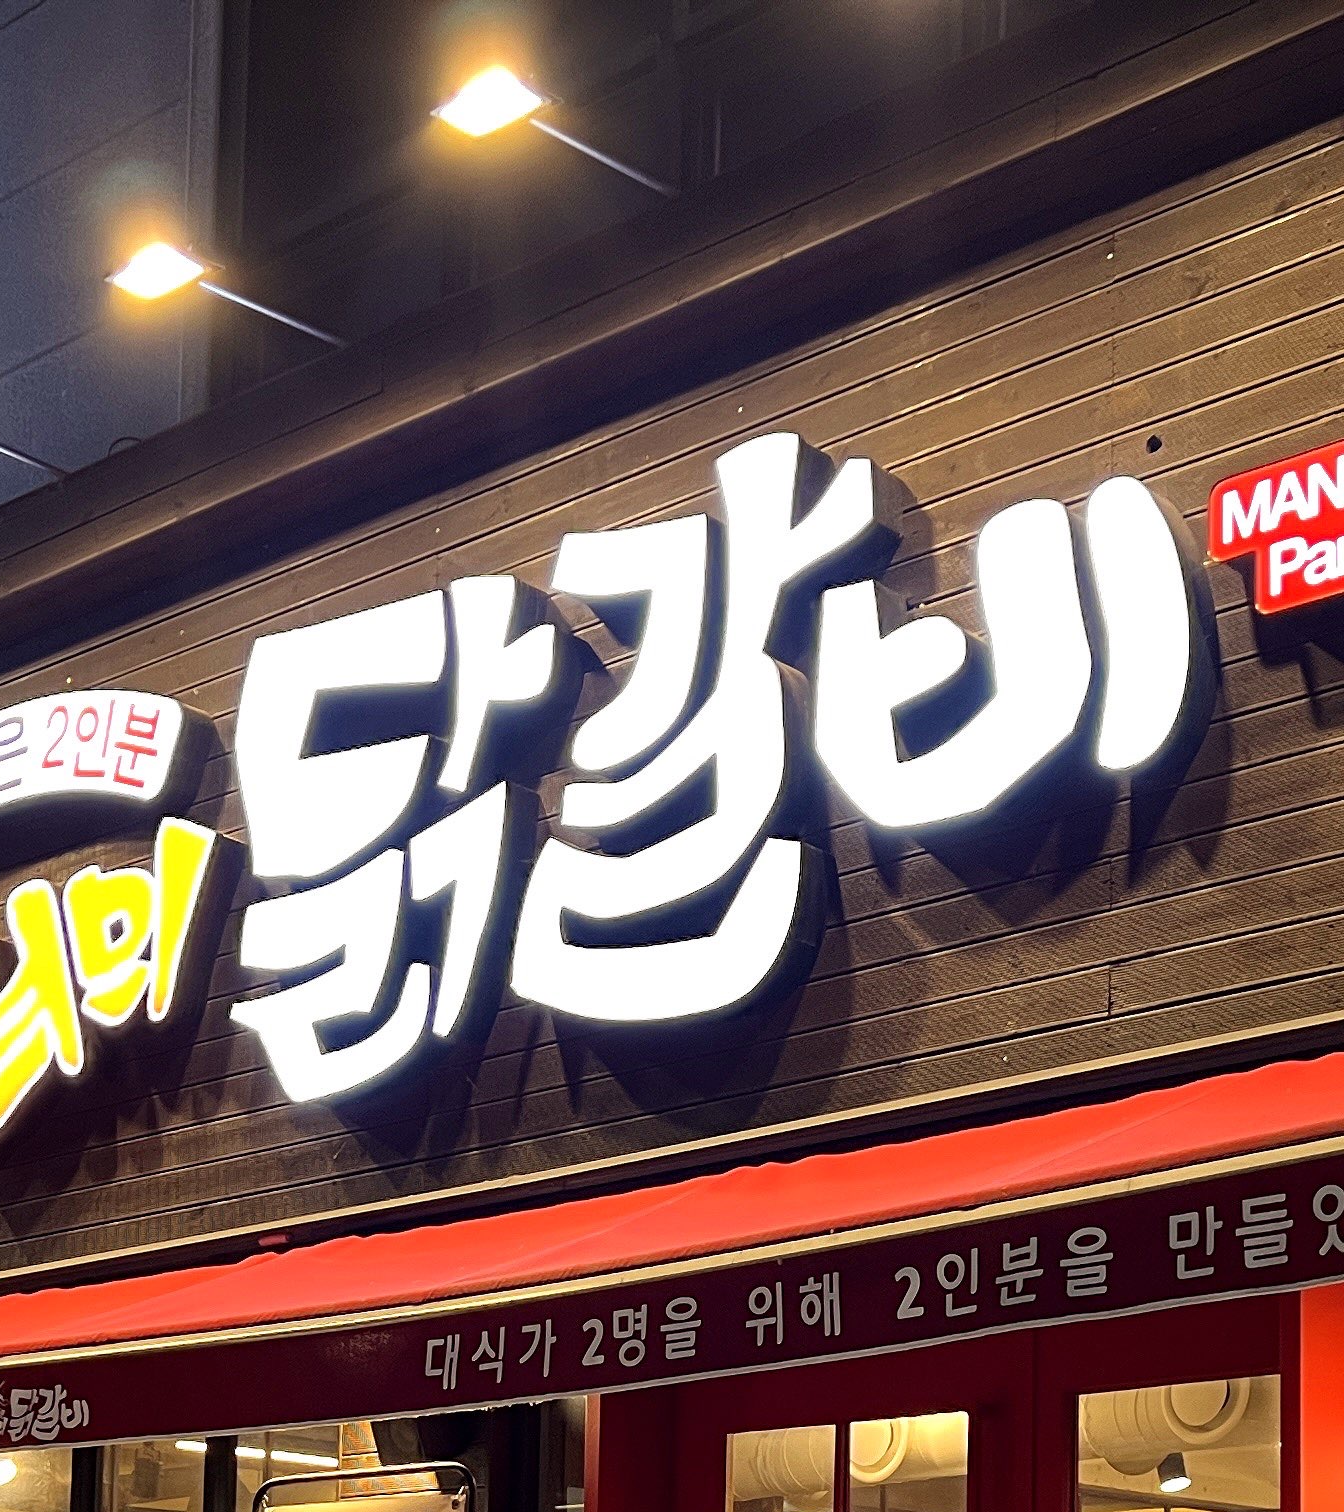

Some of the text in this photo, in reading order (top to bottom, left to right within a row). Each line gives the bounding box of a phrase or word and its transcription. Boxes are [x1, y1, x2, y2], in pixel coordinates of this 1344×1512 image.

[42, 700, 161, 789] 2인분
[231, 432, 1191, 1103] 닭갈비
[424, 1332, 558, 1392] 대식가
[581, 1297, 703, 1368] 2명을
[746, 1270, 843, 1348] 위해
[894, 1225, 1115, 1322] 2인분을
[7, 1384, 89, 1442] 닭갈비
